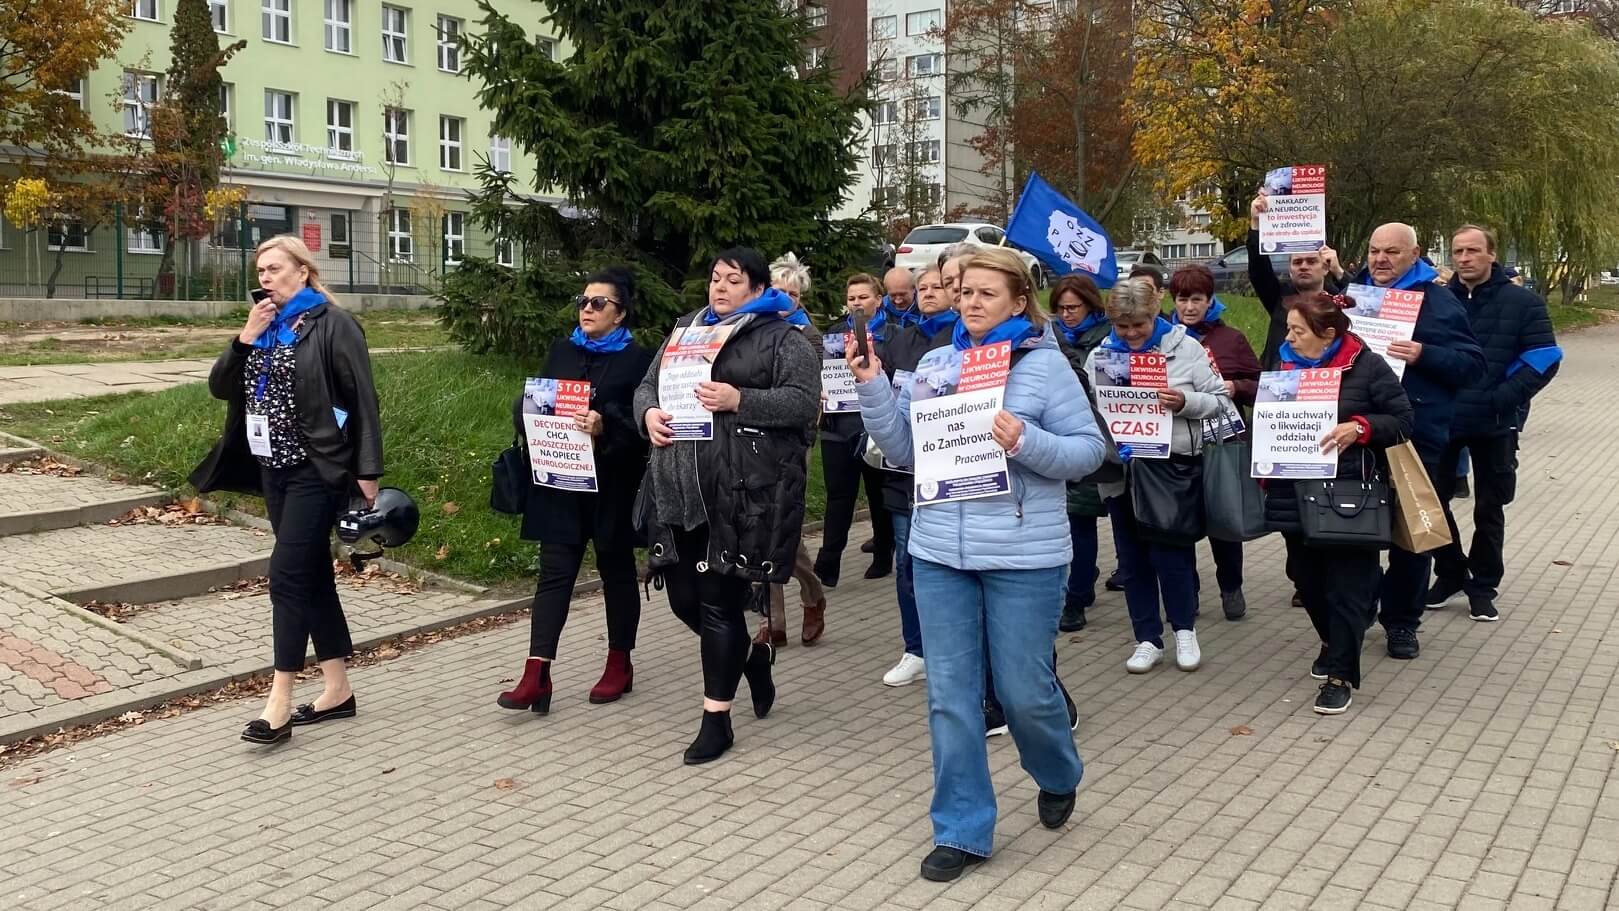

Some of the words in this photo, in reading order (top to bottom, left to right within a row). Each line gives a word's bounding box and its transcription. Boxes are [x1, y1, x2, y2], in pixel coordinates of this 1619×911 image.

[1292, 167, 1325, 176] STOP
[1277, 213, 1317, 222] inwestycja
[1384, 291, 1423, 302] STOP
[963, 344, 1010, 365] STOP
[1130, 355, 1166, 365] STOP
[961, 360, 1009, 374] LIKWIDACJI
[1300, 369, 1341, 380] STOP
[557, 383, 591, 394] STOP
[916, 397, 997, 424] Przehandlowali
[1147, 403, 1167, 416] SIĘ
[1257, 410, 1274, 420] Nie
[1275, 410, 1291, 419] dla
[1292, 409, 1334, 422] uchwały
[947, 420, 965, 433] nas
[1110, 420, 1160, 436] CZAS!
[1278, 421, 1322, 433] likwidacji
[546, 430, 569, 441] CHCĄ
[1276, 432, 1316, 441] oddziału
[922, 441, 936, 453] do
[938, 431, 993, 450] Zambrowa
[540, 449, 551, 457] NA
[552, 450, 581, 460] OPIECE
[1270, 443, 1319, 454] neurologii
[954, 448, 1004, 466] Pracownicy
[532, 458, 593, 471] NEUROLOGICZNEJ
